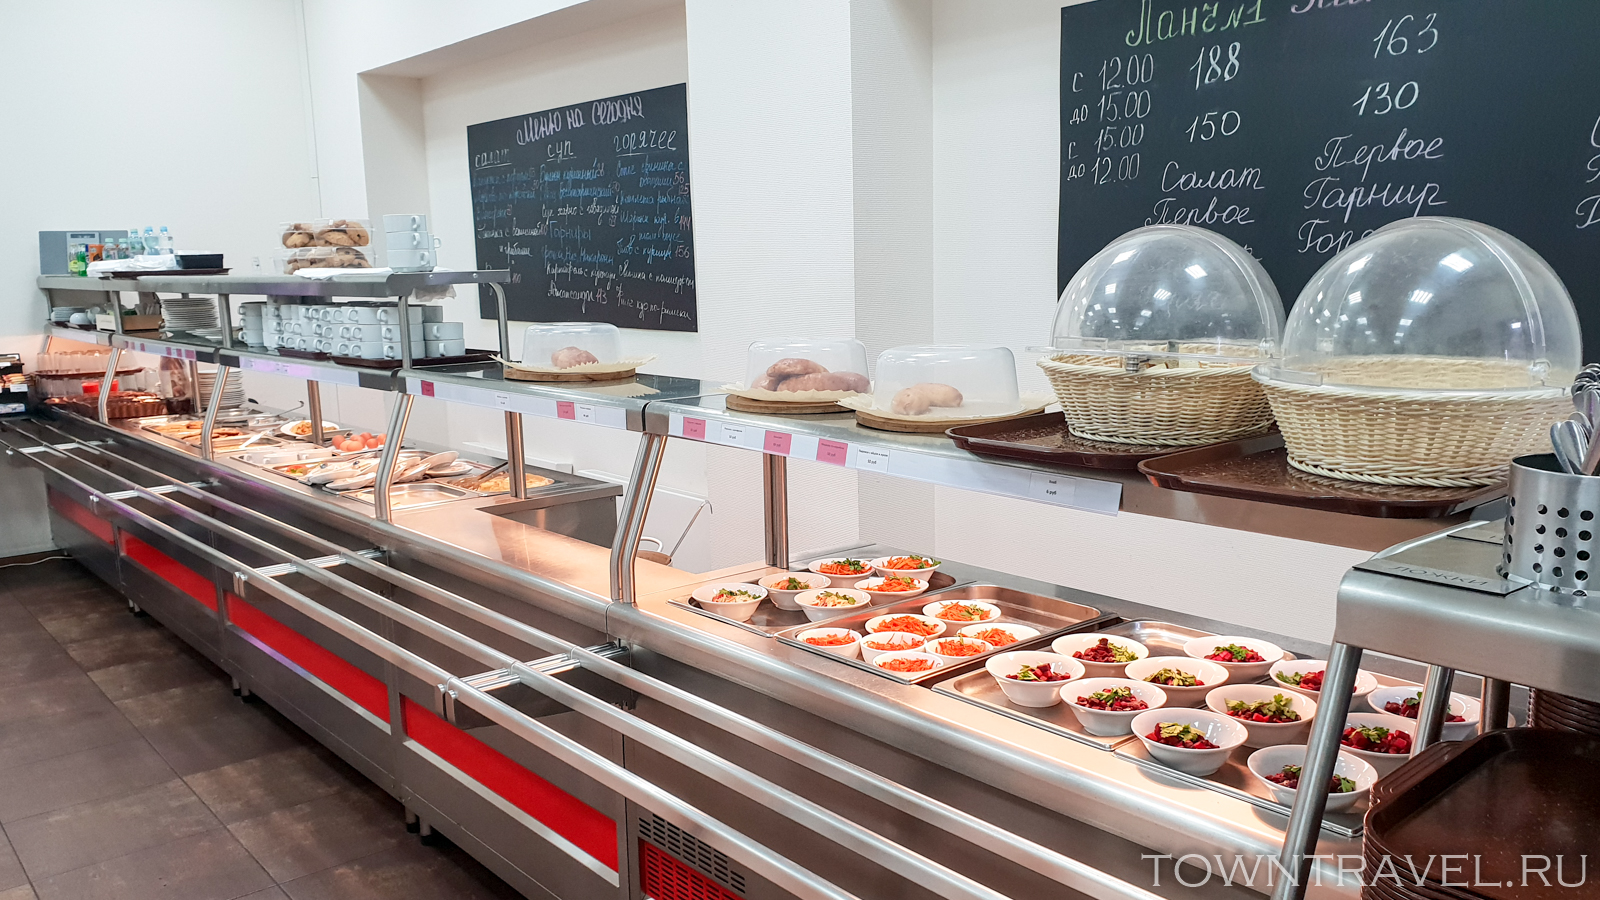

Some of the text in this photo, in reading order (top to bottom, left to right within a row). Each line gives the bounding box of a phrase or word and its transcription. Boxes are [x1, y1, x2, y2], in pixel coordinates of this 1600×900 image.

[1373, 12, 1439, 59] 163
[1098, 53, 1154, 91] 12.00
[1189, 41, 1241, 91] 188
[1097, 89, 1151, 122] 15.00
[1352, 80, 1420, 116] 130
[1094, 123, 1144, 154] 15.00
[1185, 110, 1241, 143] 150
[1091, 153, 1140, 185] 12.00
[1314, 127, 1444, 182] Первое
[673, 171, 684, 186] 56
[1161, 160, 1265, 193] Салат
[1144, 196, 1255, 226] Первое
[1303, 176, 1448, 224] Гарнир
[675, 245, 690, 259] 156
[1388, 566, 1488, 586] ЛОЖКИ
